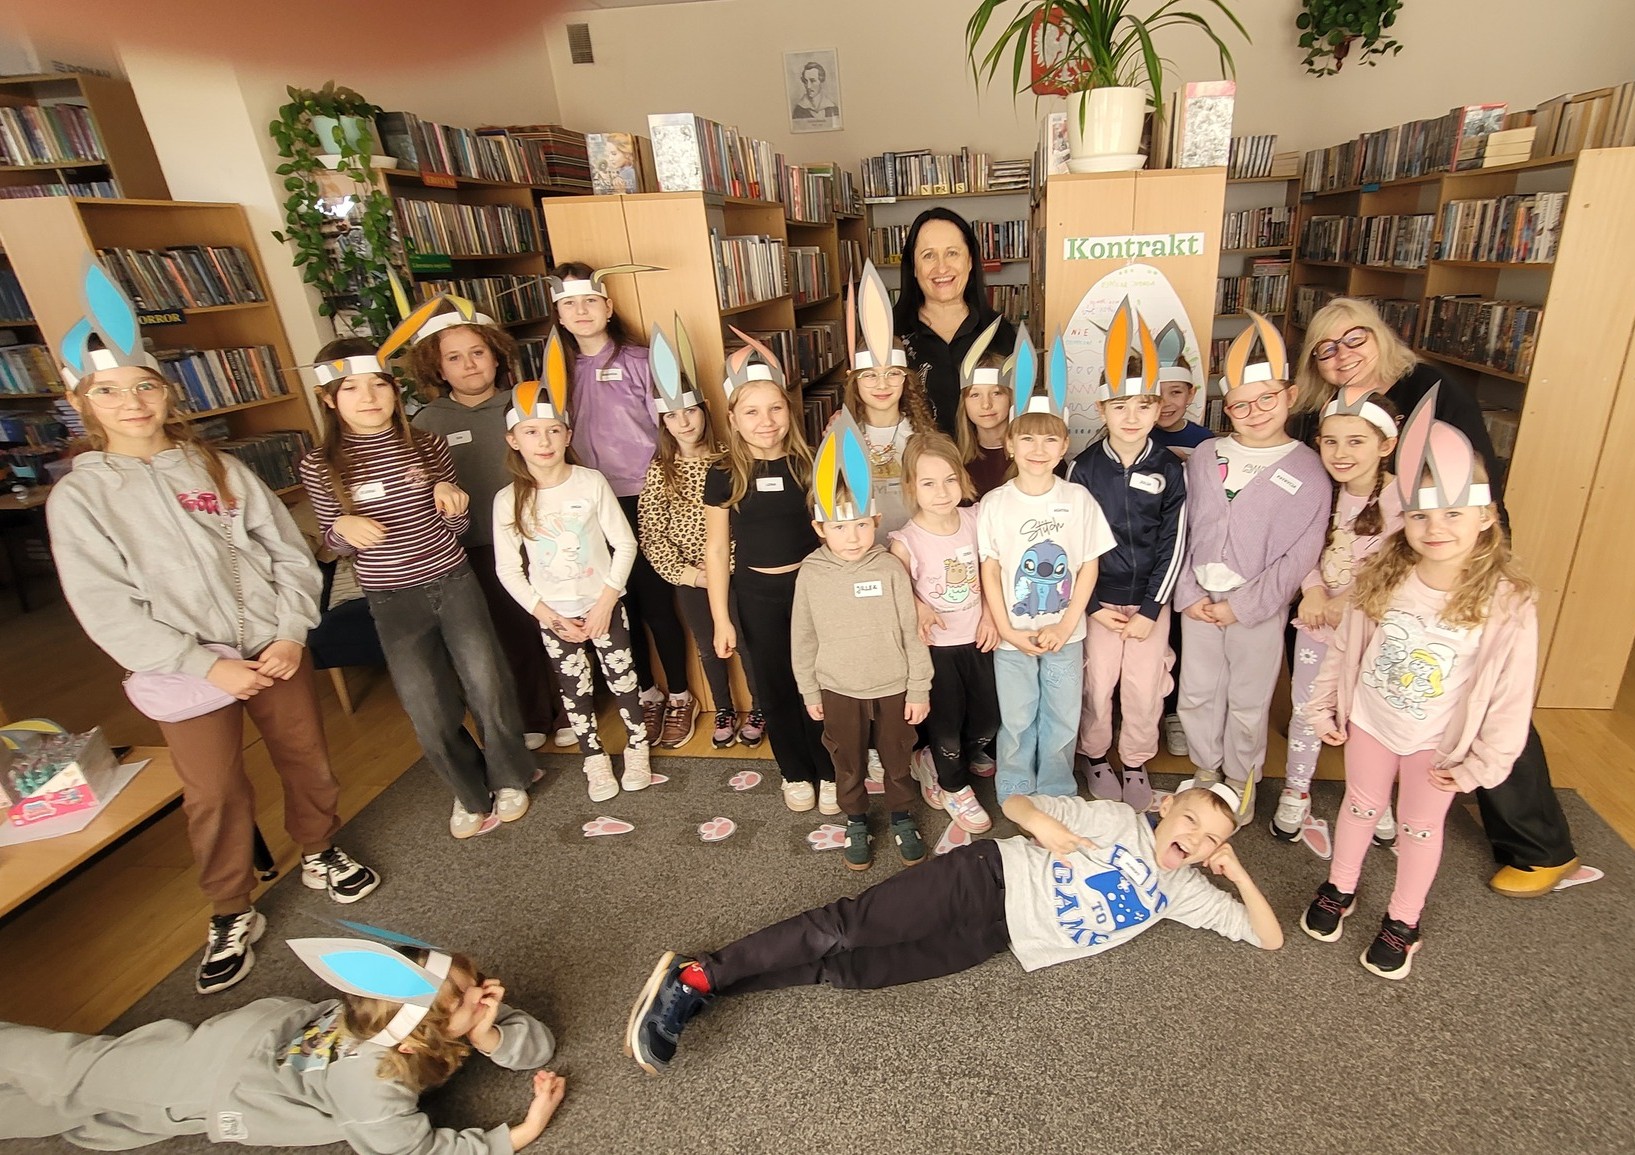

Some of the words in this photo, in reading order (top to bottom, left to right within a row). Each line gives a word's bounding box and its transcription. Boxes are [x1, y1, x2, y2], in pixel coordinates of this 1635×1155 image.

[1067, 234, 1199, 260] Kontrakt
[138, 313, 181, 324] ORROR
[1019, 516, 1065, 542] Stitch
[1091, 901, 1107, 925] TO
